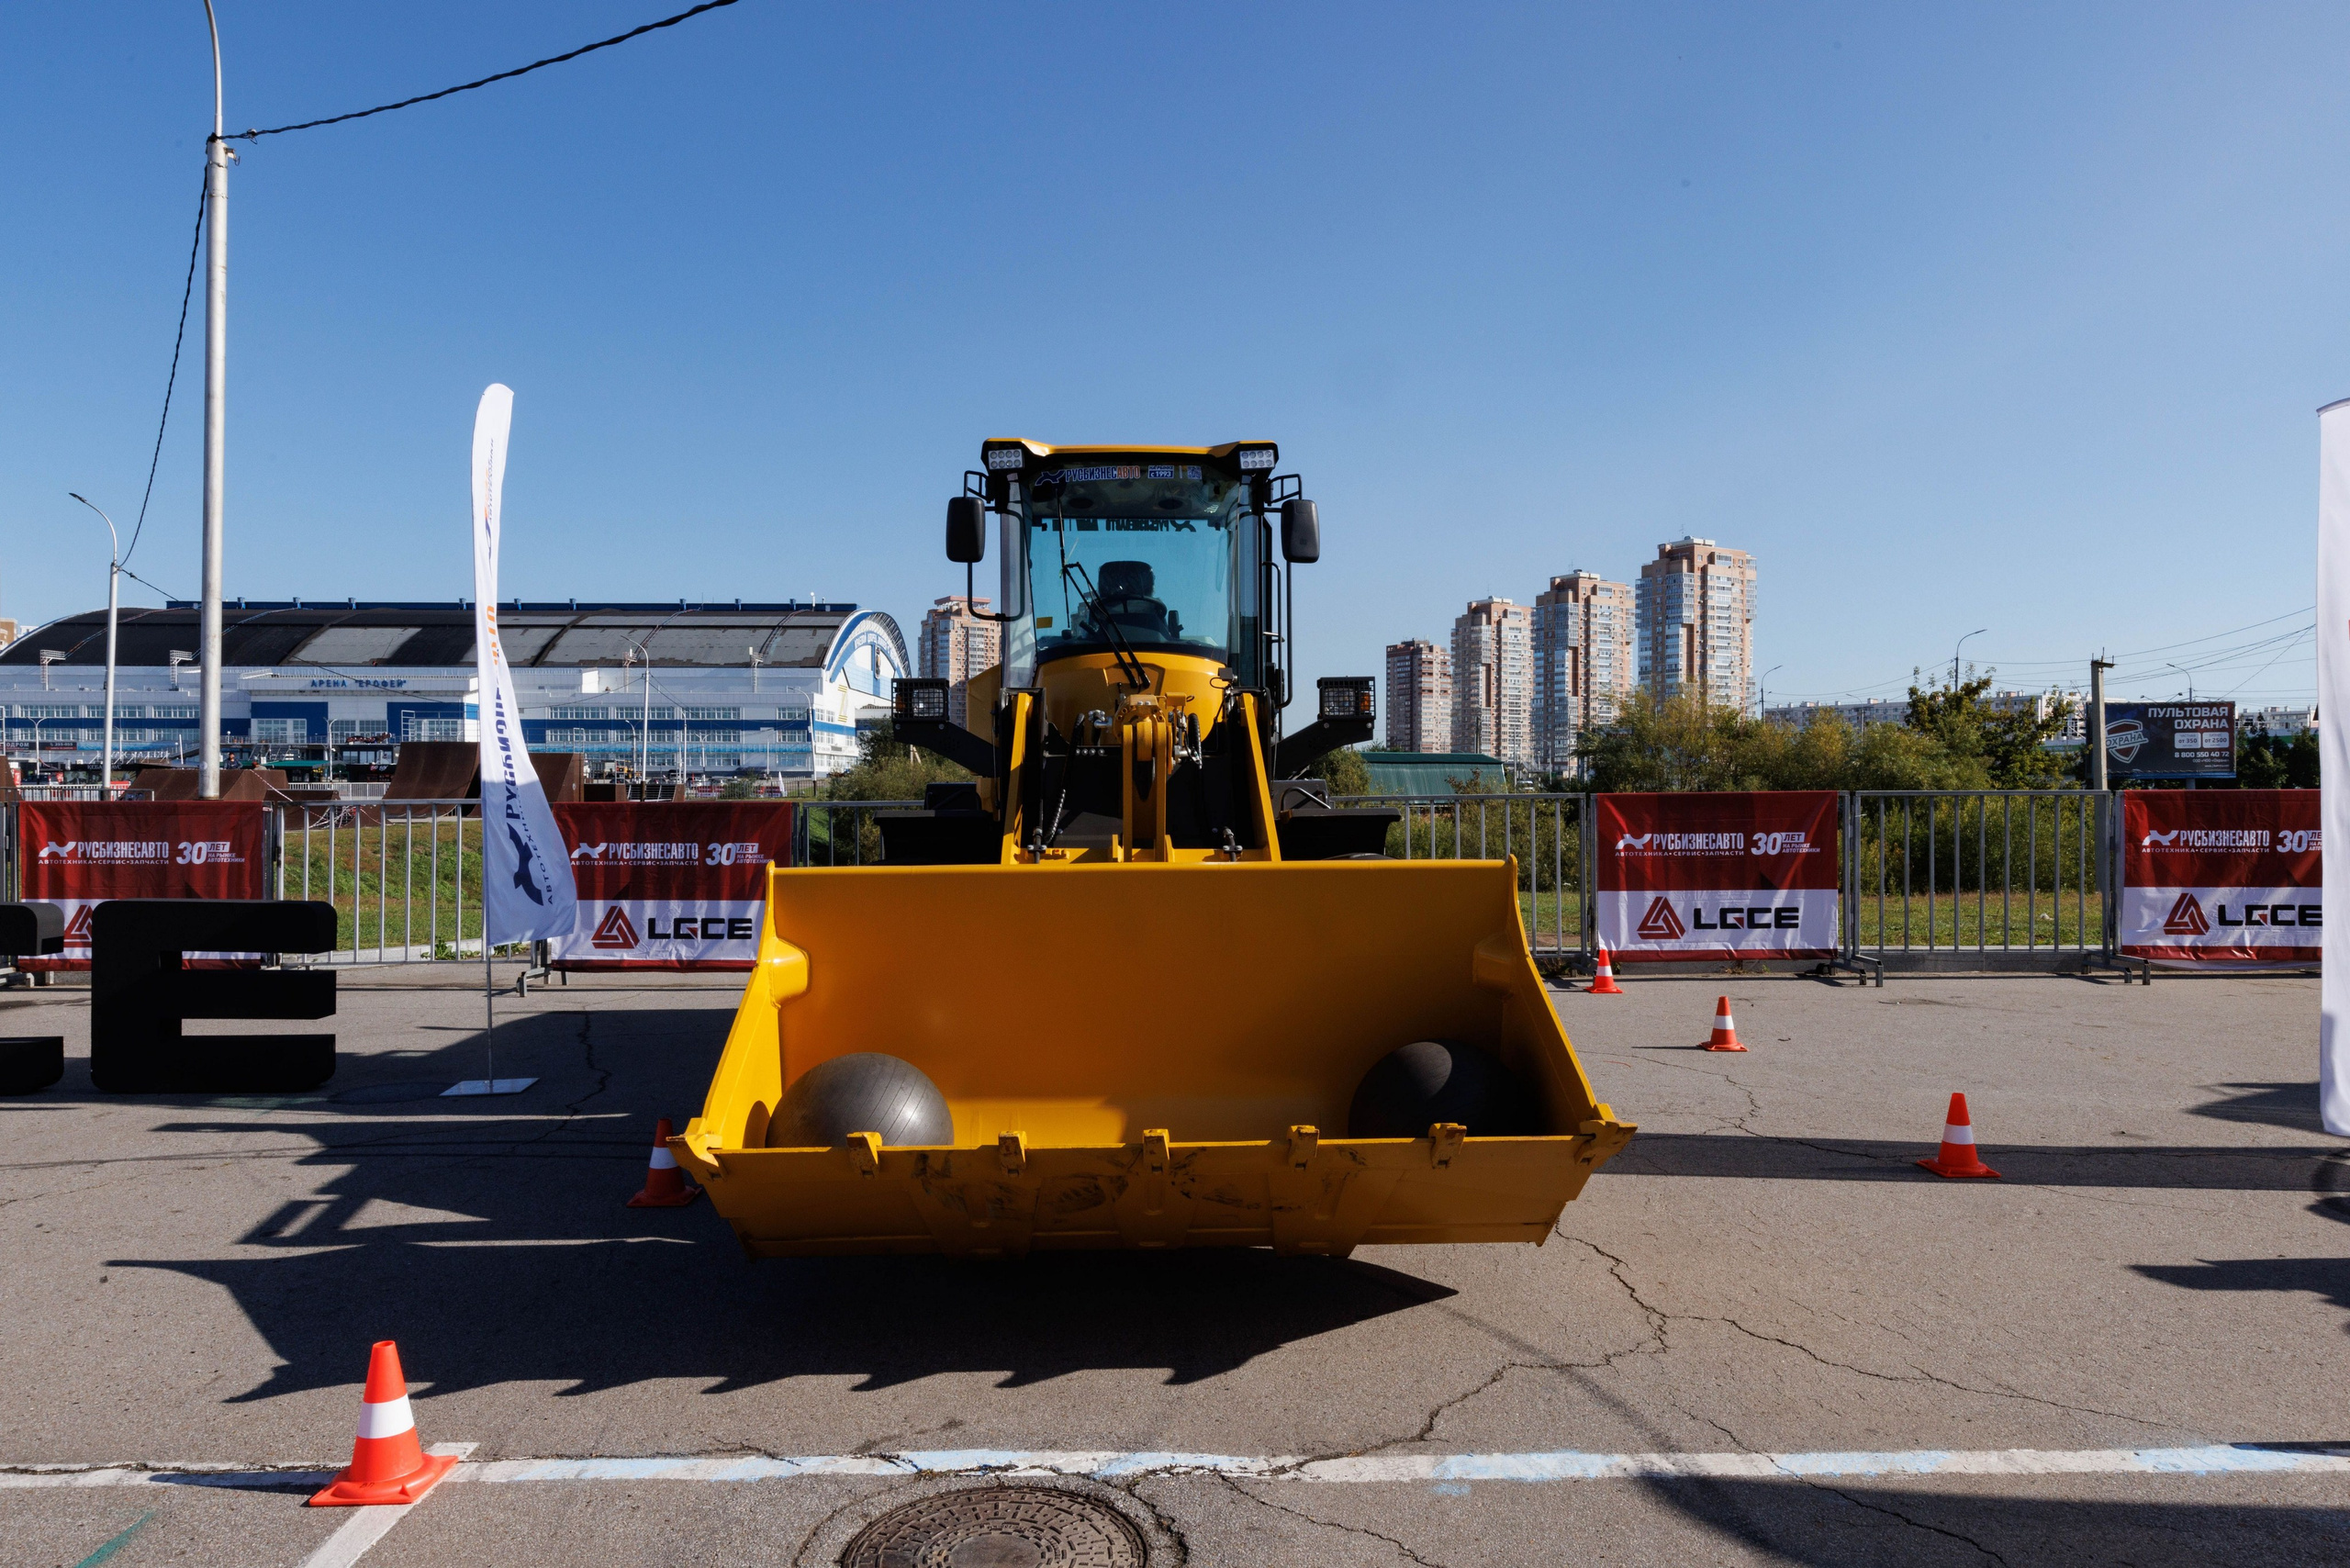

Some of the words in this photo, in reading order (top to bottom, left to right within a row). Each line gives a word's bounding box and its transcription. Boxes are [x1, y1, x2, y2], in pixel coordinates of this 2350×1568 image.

[1066, 465, 1140, 482] РУСБИЗНЕСАВТО
[2149, 707, 2228, 717] ПУЛЬТОВАЯ
[2175, 719, 2229, 729] ОХРАНА
[2106, 733, 2143, 747] ОХРАНА
[1653, 834, 1743, 849] РУСБИЗНЕСАВТО
[1751, 833, 1782, 855] 30
[1784, 834, 1802, 842] ЛЕТ
[2180, 830, 2269, 846] РУСБИЗНЕСАВТО
[2277, 830, 2308, 853] 30
[78, 842, 169, 857] РУСБИЗНЕСАВТО
[176, 842, 208, 864] 30
[208, 843, 226, 851] ЛЕТ
[610, 843, 699, 859] РУСБИЗНЕСАВТО
[706, 843, 736, 866] 30
[737, 844, 755, 852] ЛЕТ
[1694, 907, 1799, 929] LGCE
[2218, 904, 2322, 926] LGCE
[648, 918, 752, 940] LGCE
[0, 898, 337, 1096] E
